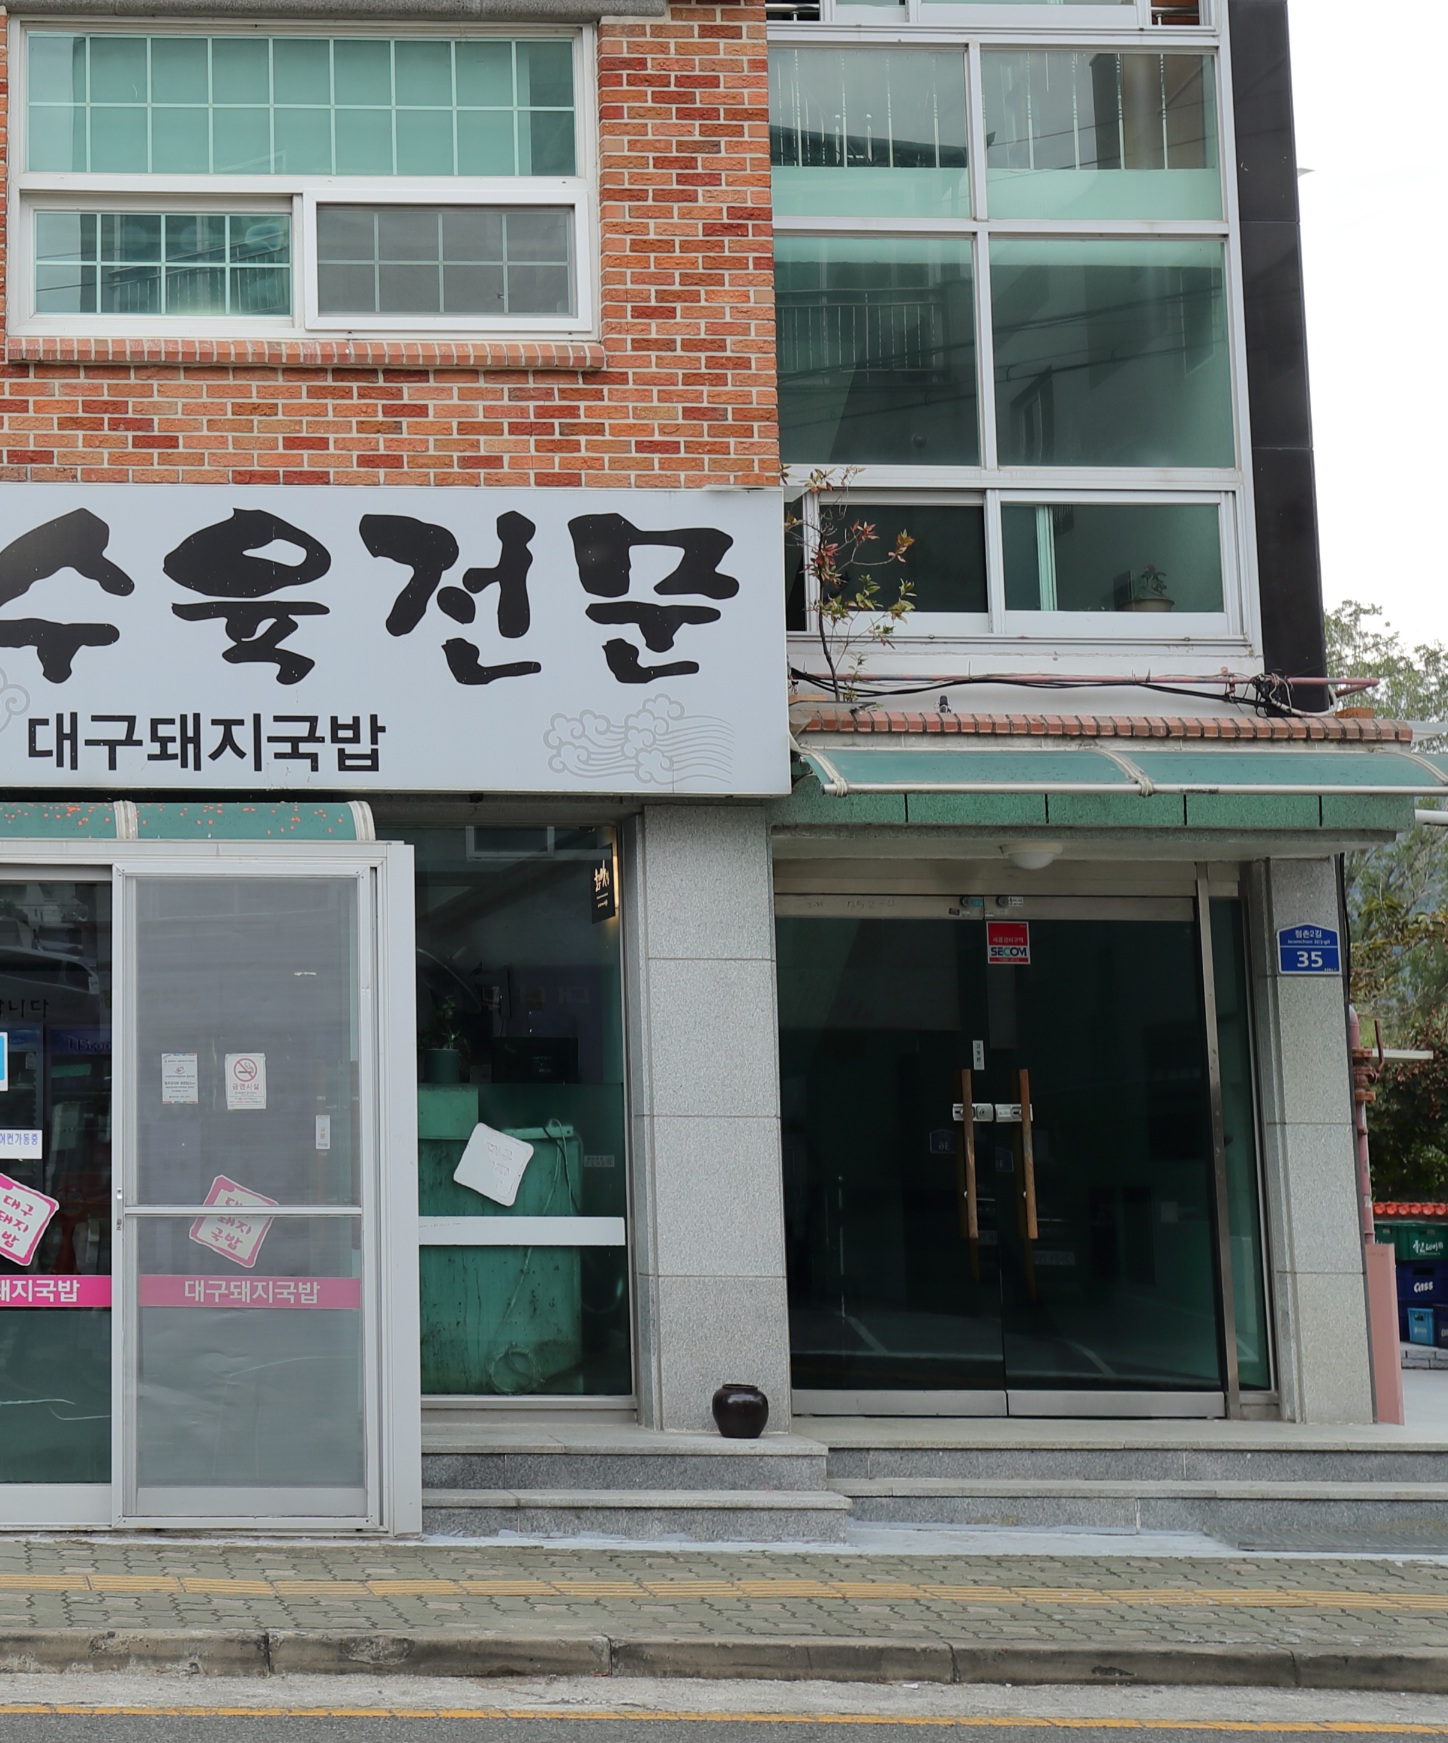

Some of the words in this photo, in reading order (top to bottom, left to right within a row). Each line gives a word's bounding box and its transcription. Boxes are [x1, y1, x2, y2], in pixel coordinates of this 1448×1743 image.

[27, 712, 387, 773] 대구돼지국밥
[991, 946, 1027, 956] SECOM
[1297, 951, 1323, 968] 35
[3, 1194, 35, 1217] 대구
[210, 1227, 243, 1250] 국밥
[184, 1280, 320, 1304] 대구돼지국밥
[1413, 1281, 1434, 1293] Cass
